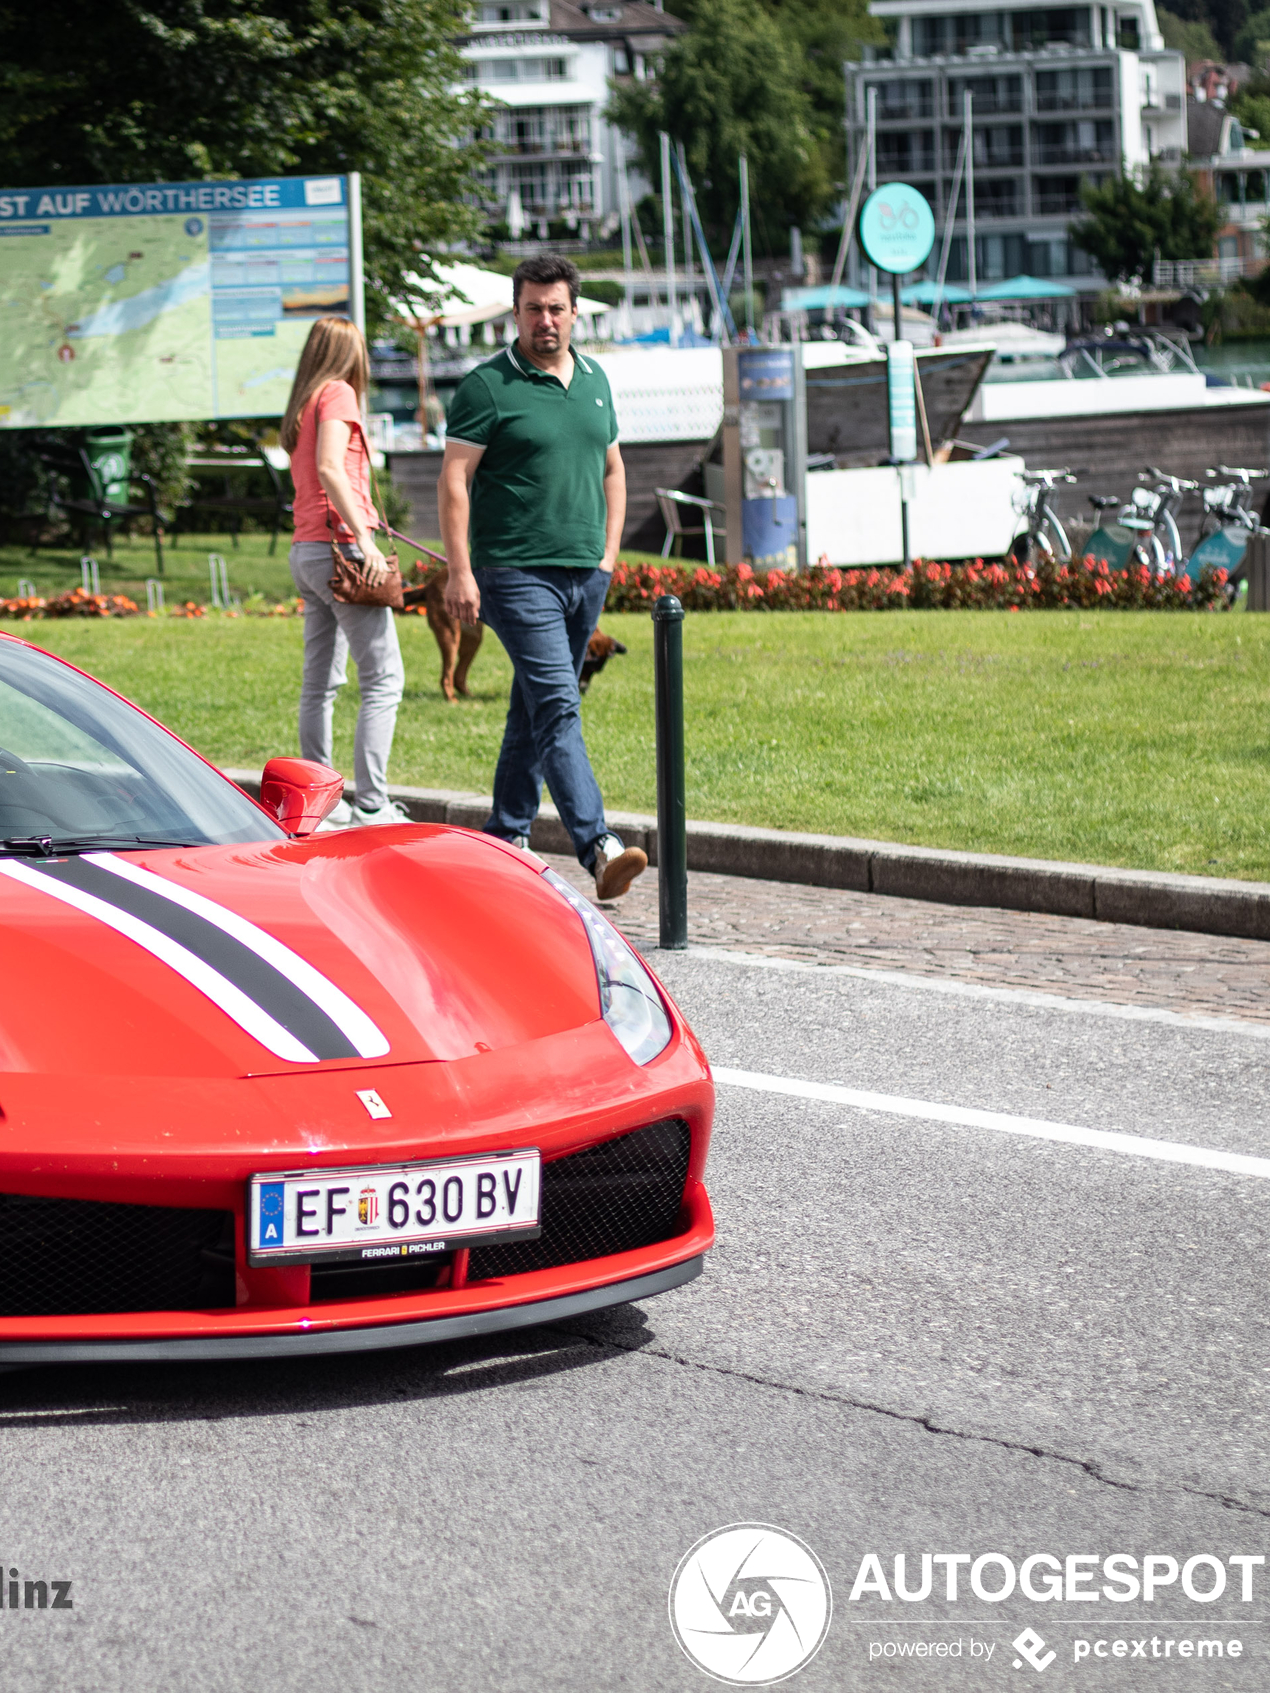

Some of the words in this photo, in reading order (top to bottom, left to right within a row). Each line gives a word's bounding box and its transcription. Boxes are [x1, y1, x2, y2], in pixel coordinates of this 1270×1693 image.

[36, 192, 92, 216] AUF
[96, 184, 281, 214] WÖRTHERSEE
[296, 1186, 350, 1236] EF
[387, 1175, 464, 1229] 630
[476, 1167, 523, 1219] BV
[265, 1222, 278, 1239] A
[362, 1246, 400, 1258] FERRARI
[409, 1241, 445, 1253] PICHLER
